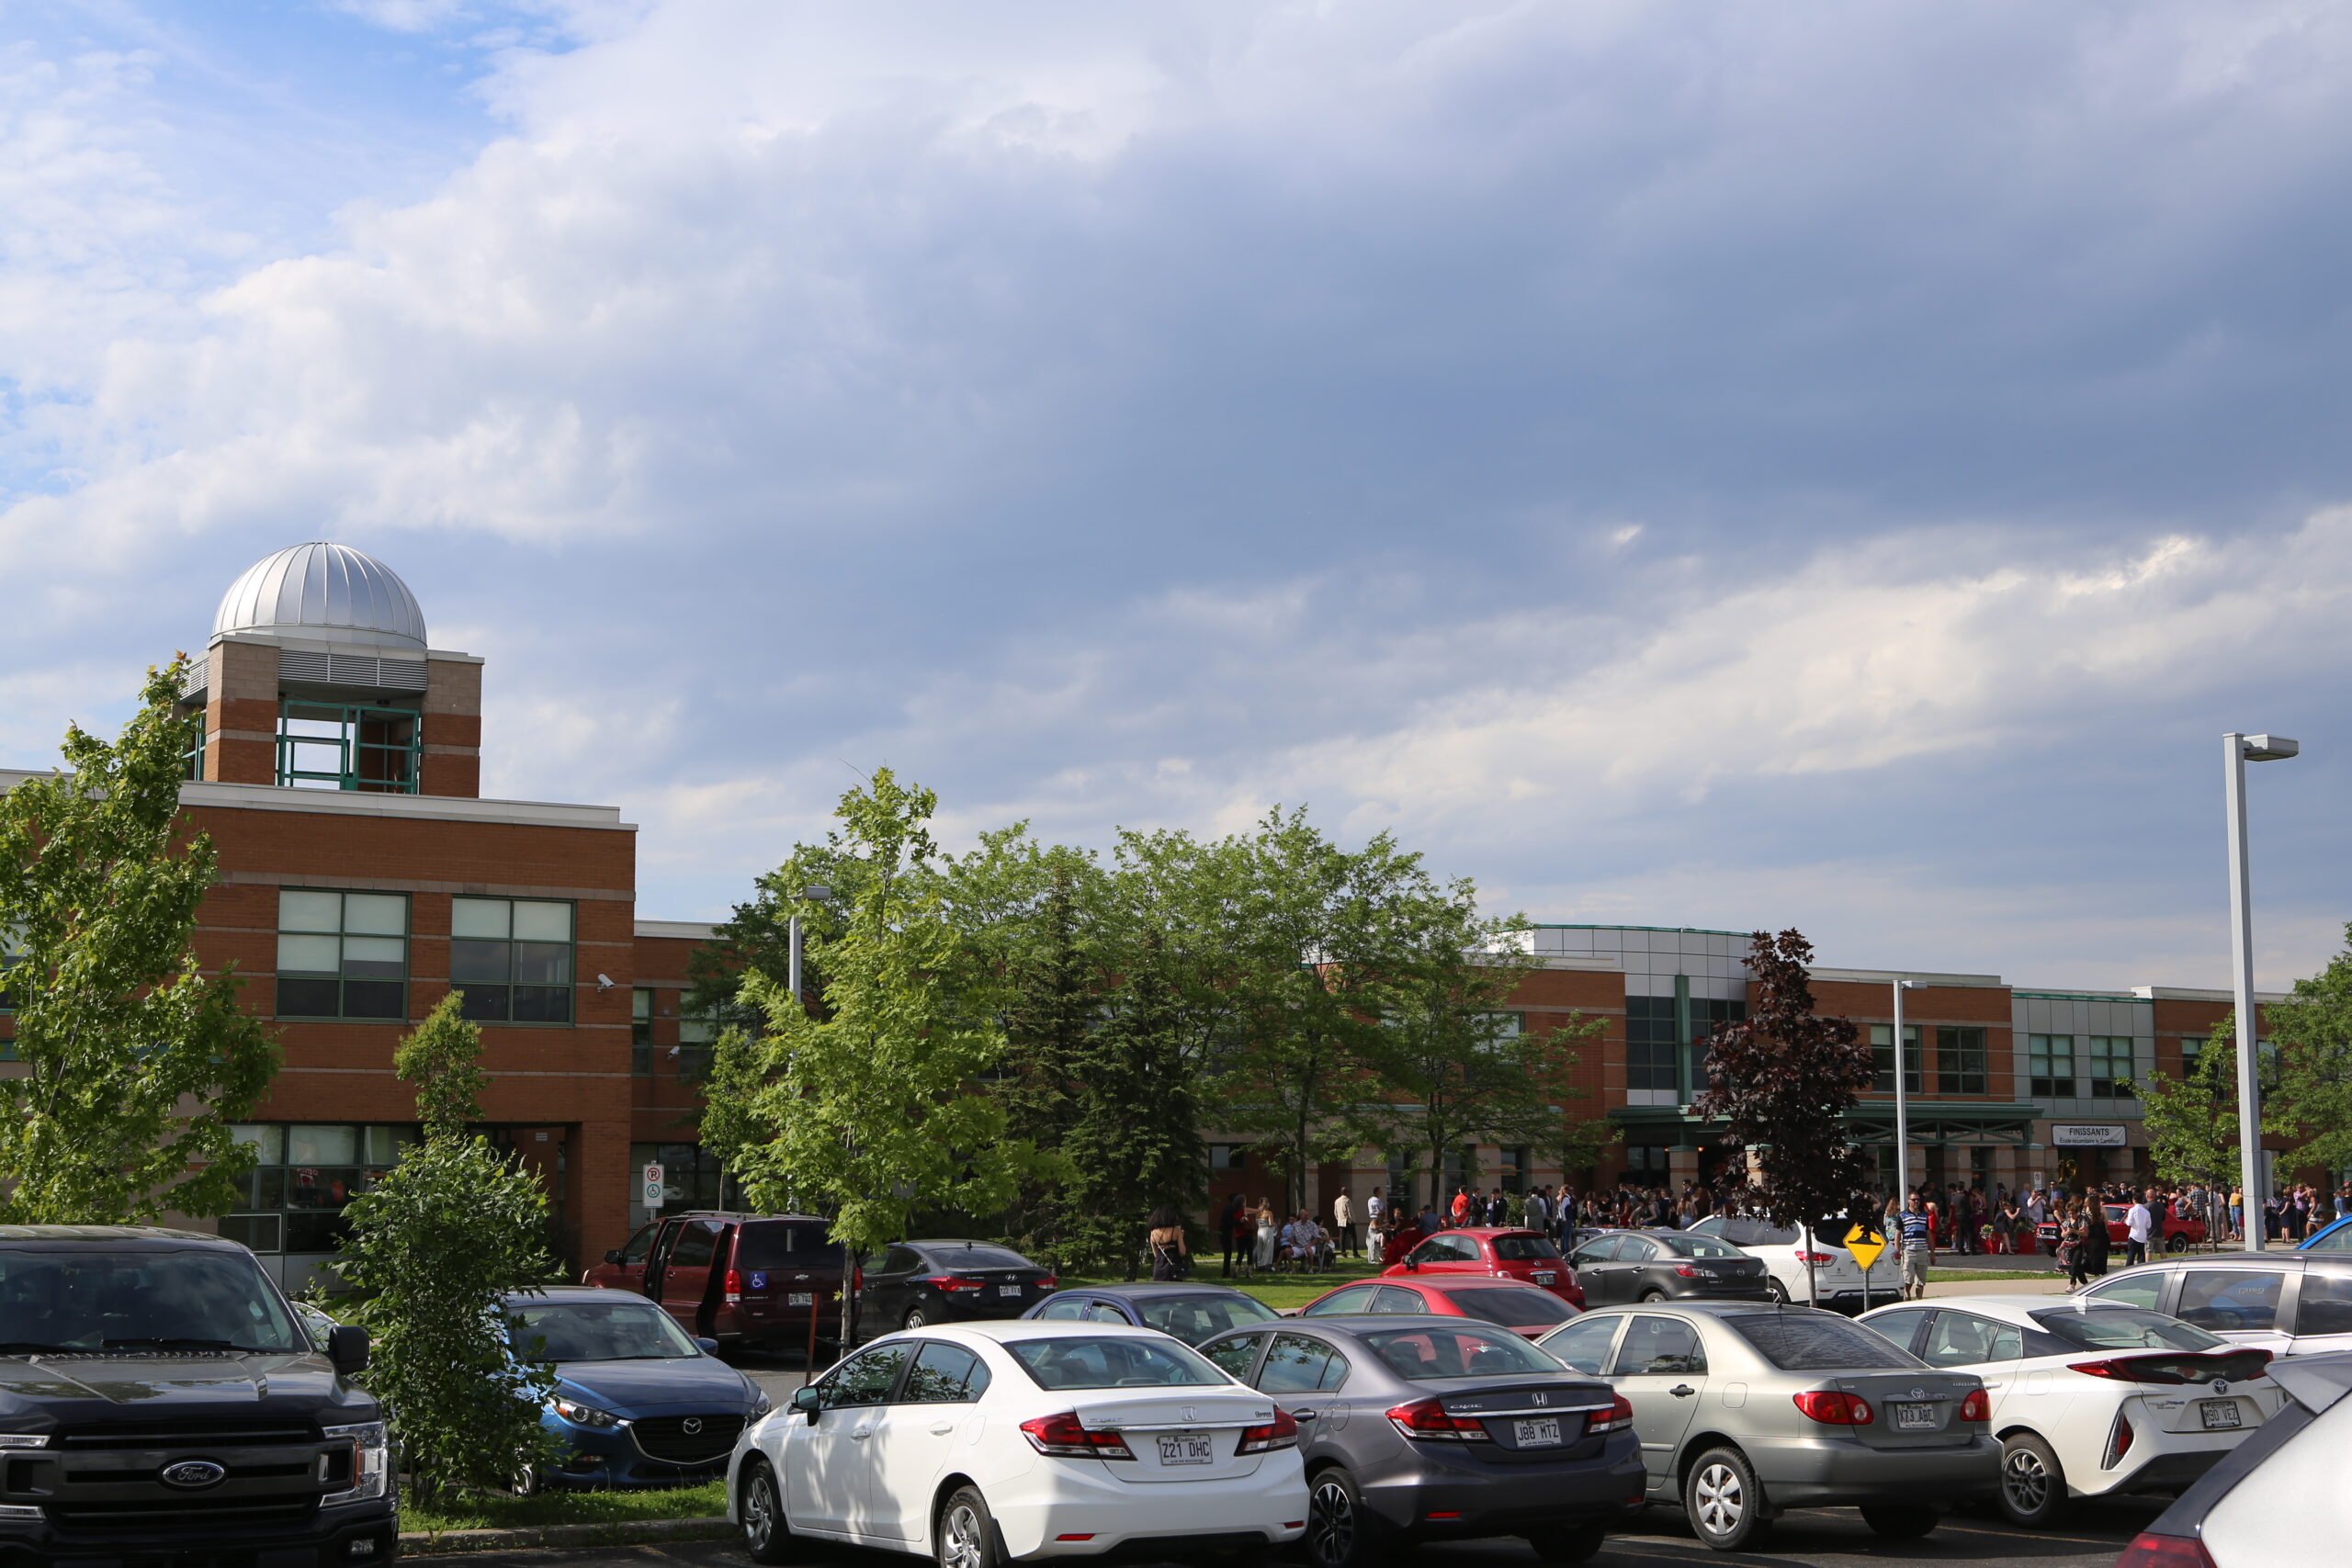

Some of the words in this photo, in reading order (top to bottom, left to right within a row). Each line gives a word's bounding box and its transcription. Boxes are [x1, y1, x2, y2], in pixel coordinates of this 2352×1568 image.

[2069, 1127, 2110, 1136] FINISSANTS
[2222, 1406, 2238, 1421] VEZ
[1518, 1426, 1536, 1440] J88
[1540, 1424, 1559, 1439] MTZ
[1161, 1442, 1182, 1459] Z21
[1188, 1441, 1210, 1457] DHC
[177, 1465, 210, 1481] Ford
